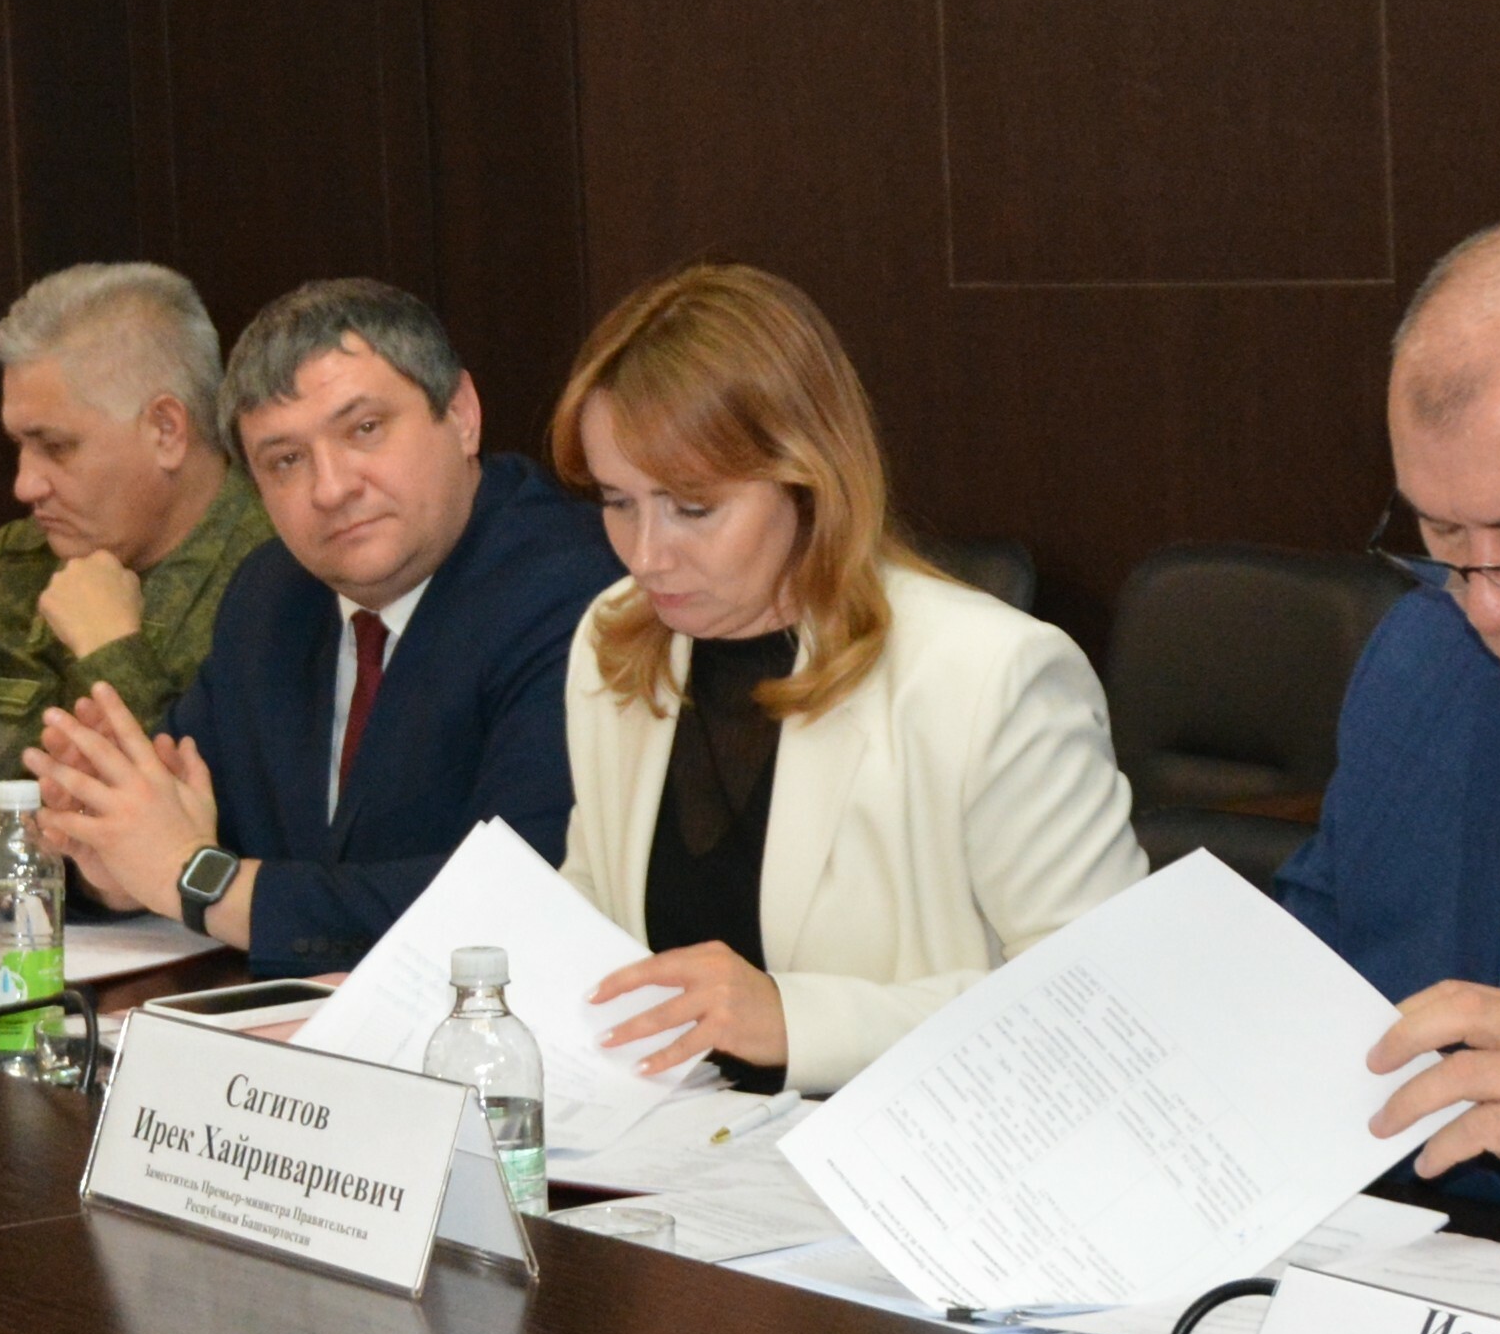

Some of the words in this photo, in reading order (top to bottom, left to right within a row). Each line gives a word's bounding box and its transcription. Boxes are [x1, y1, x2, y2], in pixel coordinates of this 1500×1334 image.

[225, 1073, 331, 1131] Сагитов
[132, 1105, 196, 1154] Ирек
[197, 1123, 405, 1213] Хайривариевич
[144, 1163, 199, 1191] Заместитель
[201, 1179, 291, 1220] Премьер-министра
[292, 1207, 368, 1241] Правительства
[184, 1196, 239, 1226] Республики
[241, 1213, 311, 1247] Башкортостан
